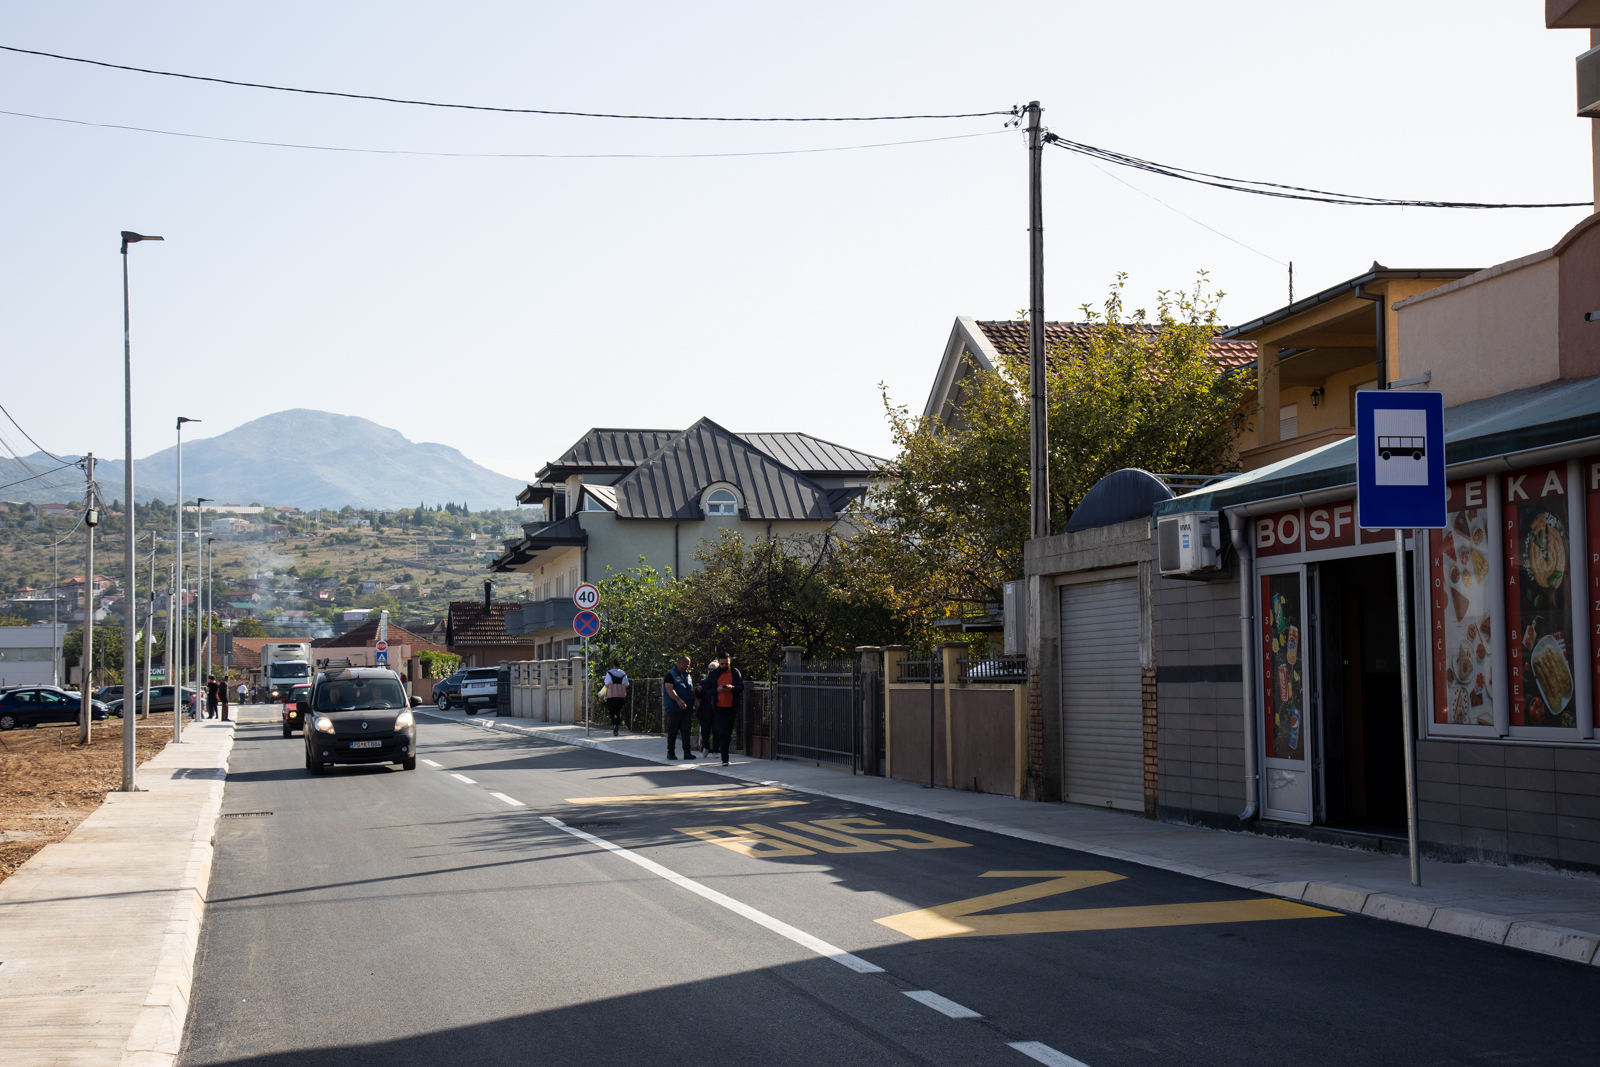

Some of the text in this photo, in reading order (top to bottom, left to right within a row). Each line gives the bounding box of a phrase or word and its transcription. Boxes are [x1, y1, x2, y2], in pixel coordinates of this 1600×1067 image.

[1507, 520, 1516, 585] PITA
[577, 591, 595, 603] 40
[1434, 557, 1443, 671] KOLAČI
[1511, 630, 1520, 713] BUREK
[671, 817, 975, 859] BUS
